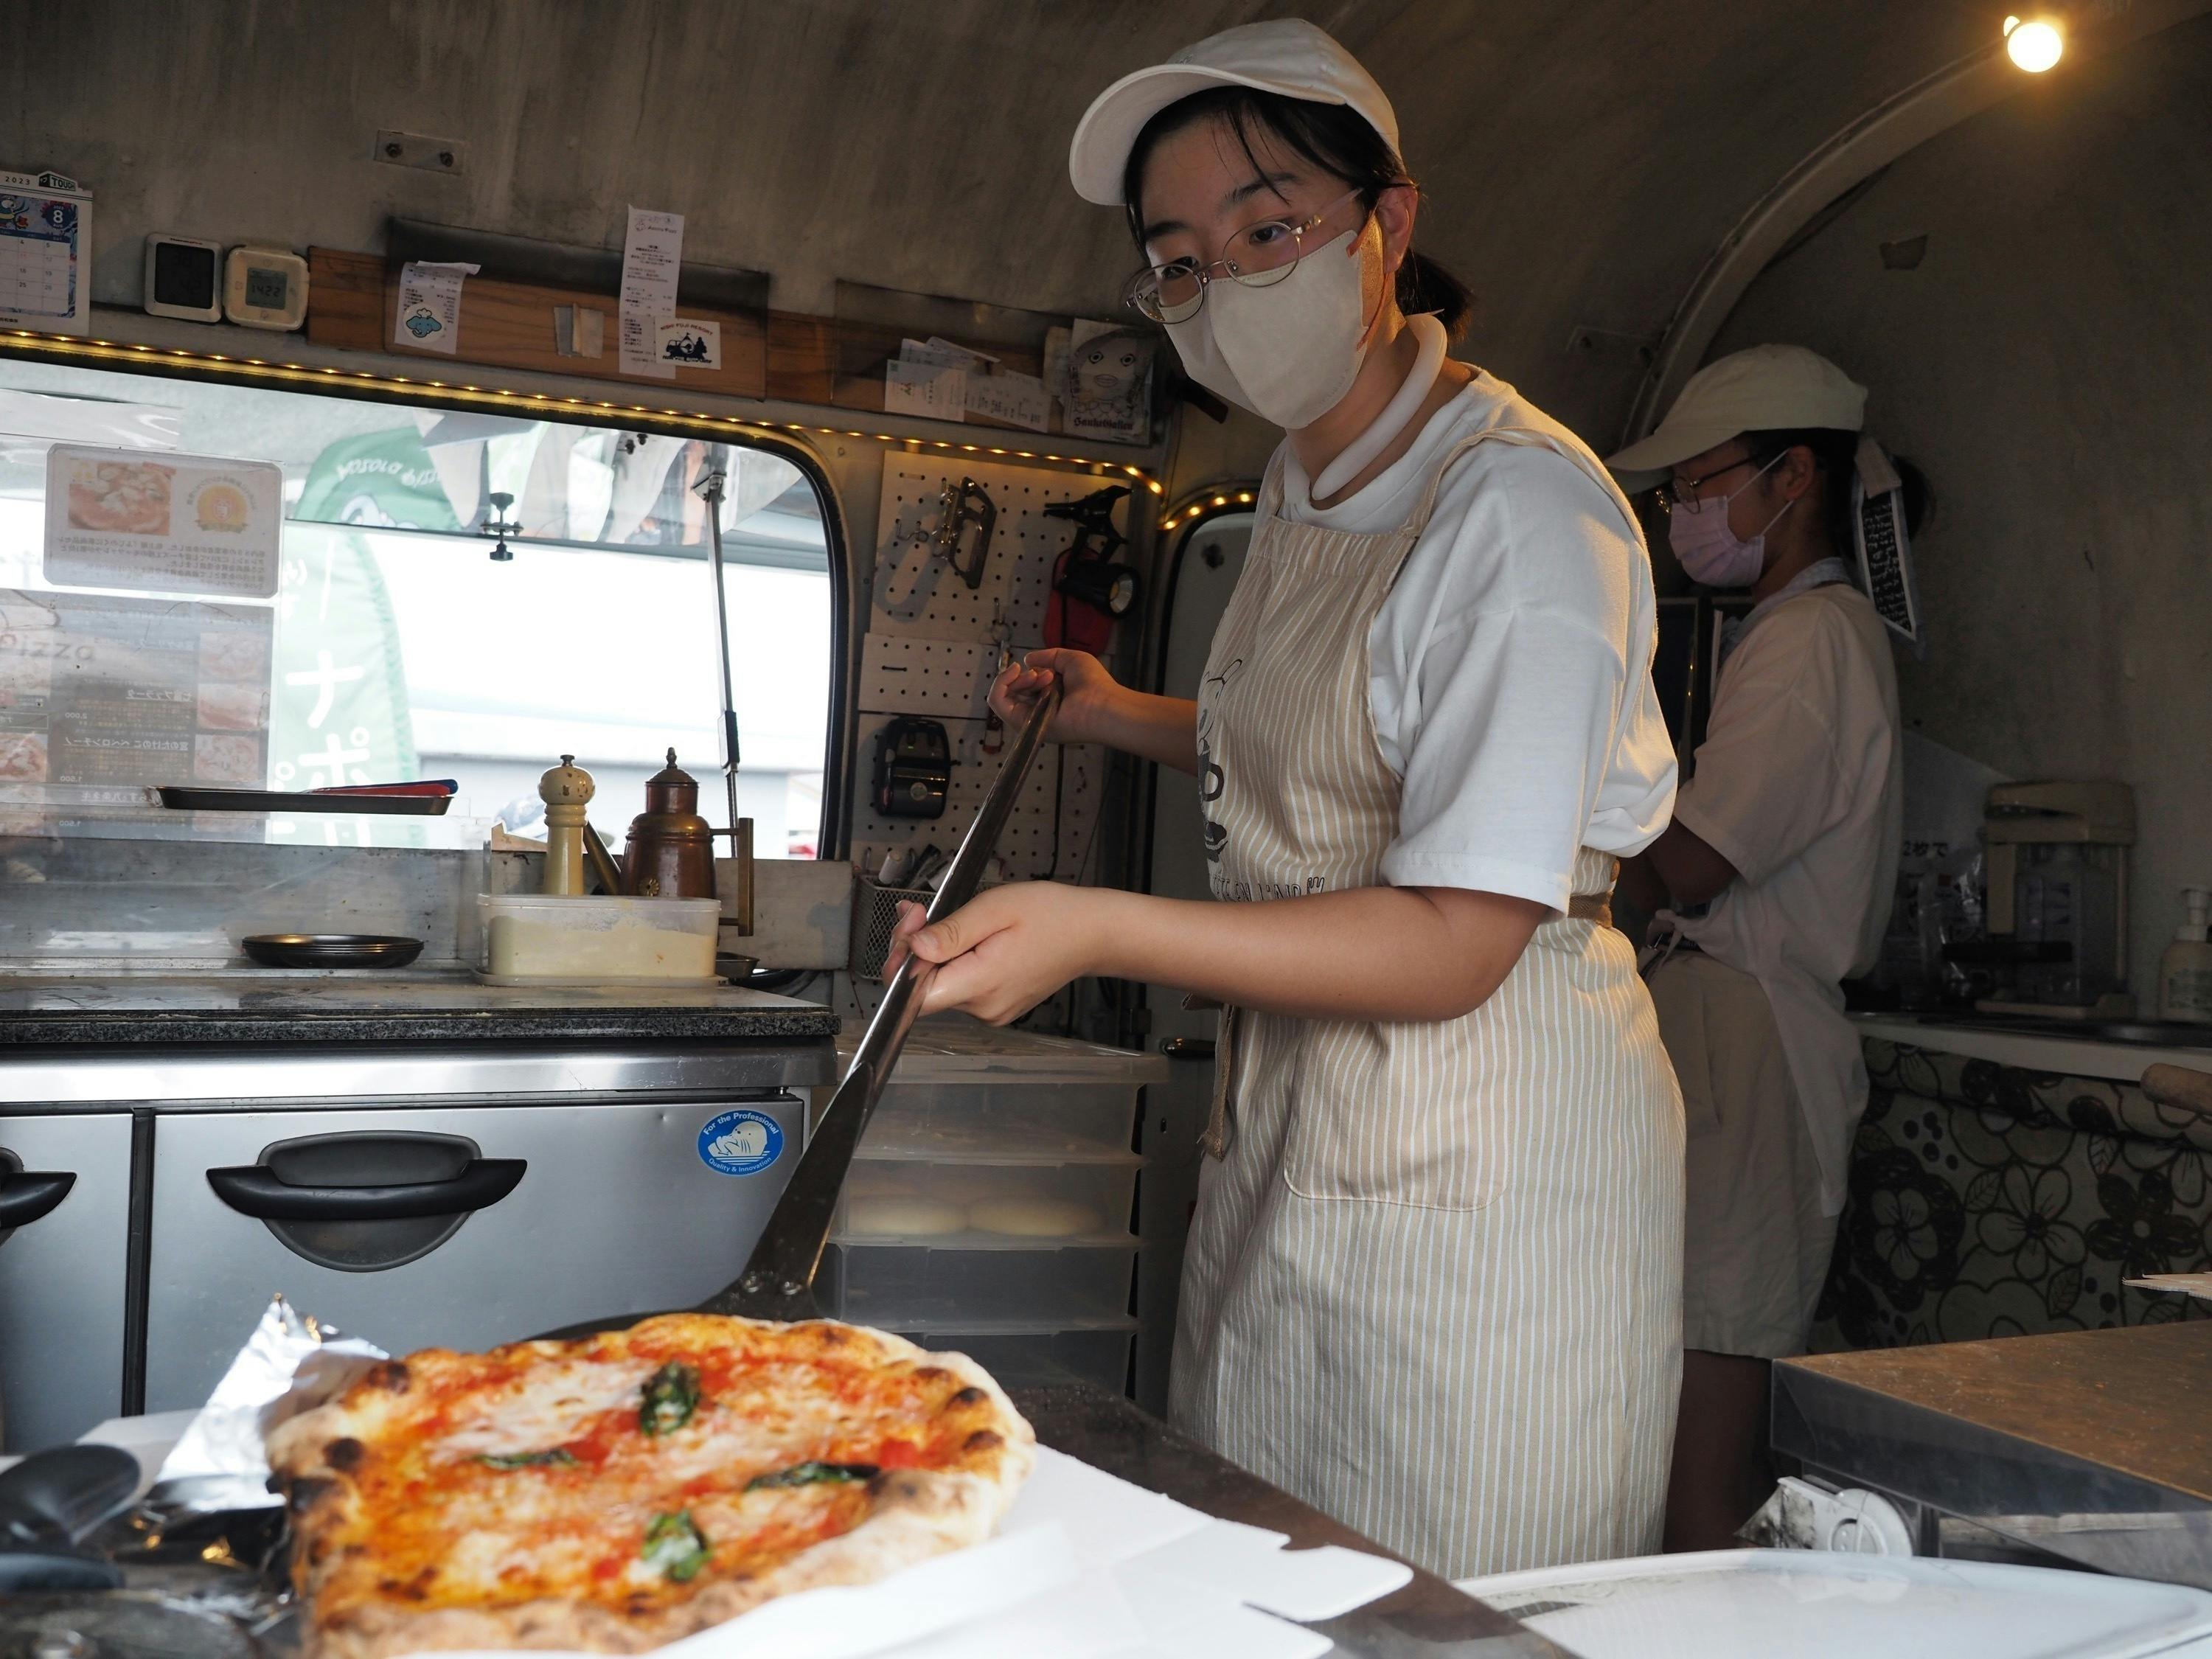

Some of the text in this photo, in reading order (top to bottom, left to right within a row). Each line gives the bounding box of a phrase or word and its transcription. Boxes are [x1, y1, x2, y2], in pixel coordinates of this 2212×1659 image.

[5, 176, 30, 185] 2023
[53, 210, 63, 223] 8
[703, 1112, 779, 1135] For the Professional
[708, 1157, 731, 1172] Quality
[738, 1157, 772, 1172] Innovation
